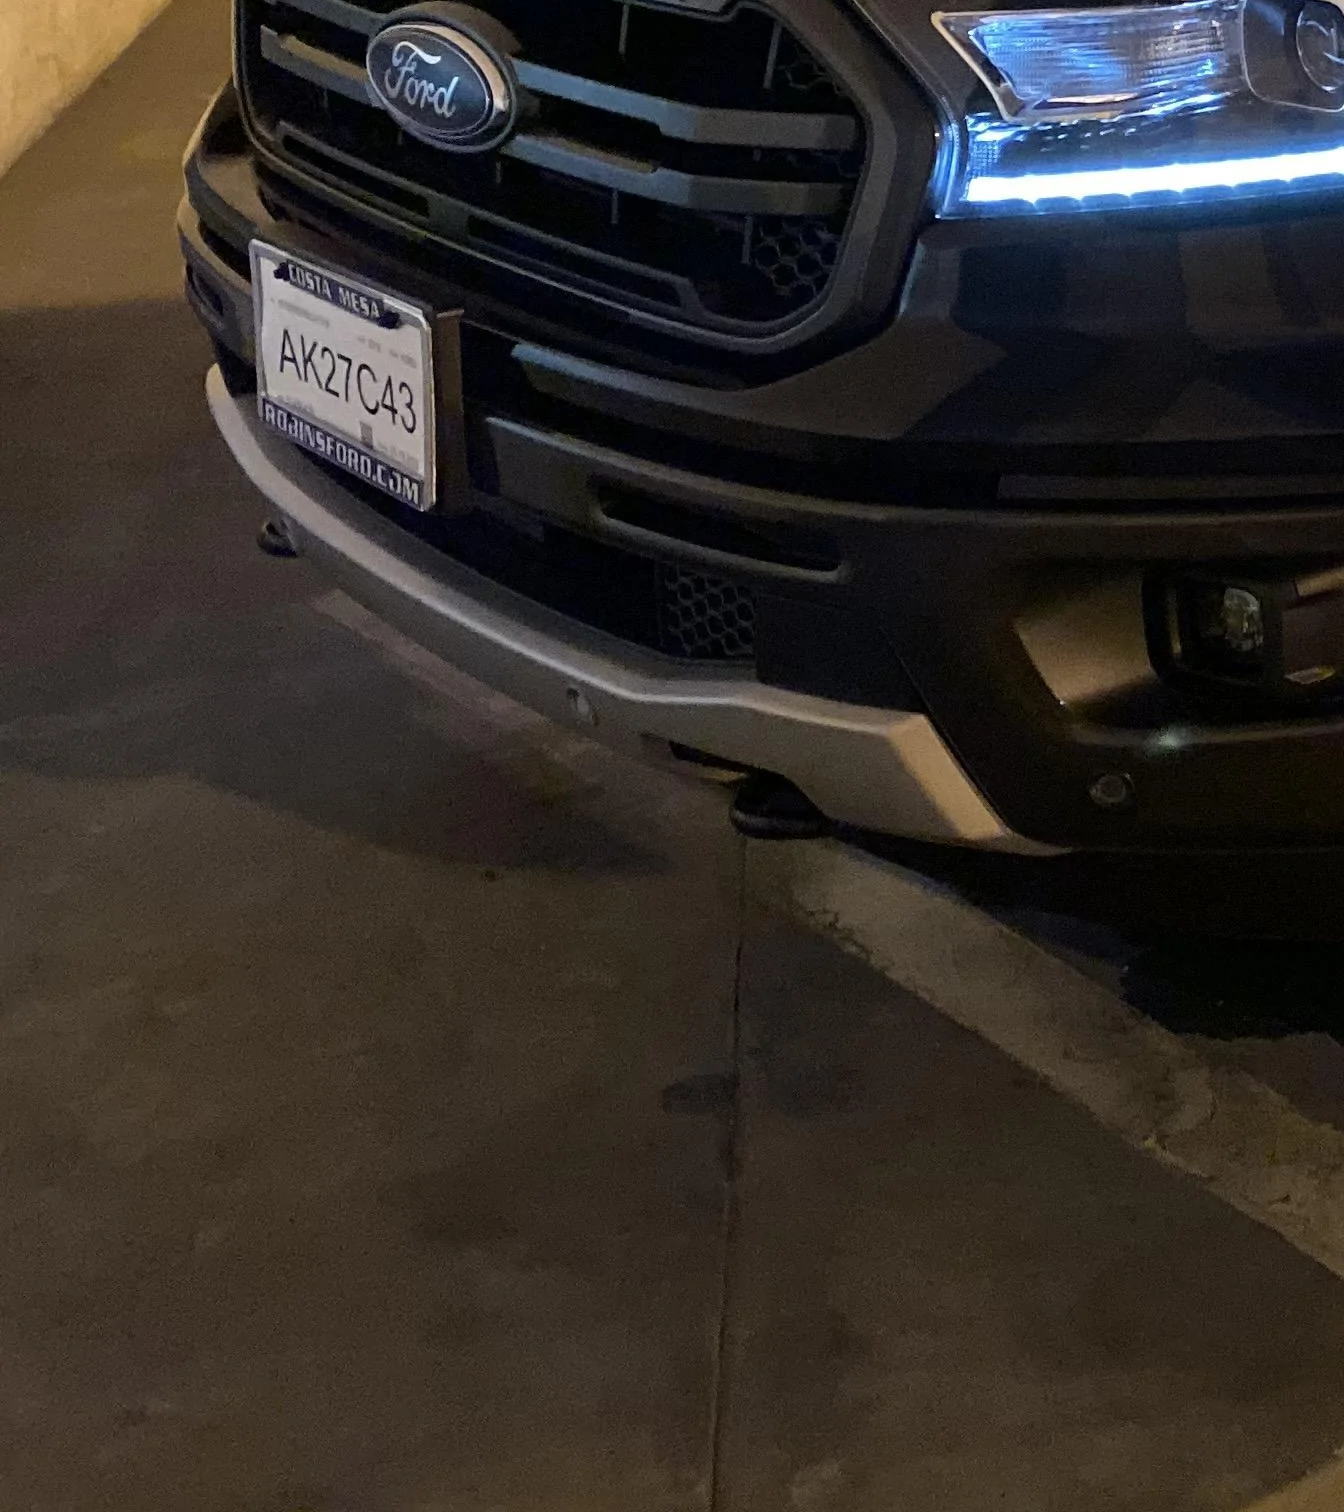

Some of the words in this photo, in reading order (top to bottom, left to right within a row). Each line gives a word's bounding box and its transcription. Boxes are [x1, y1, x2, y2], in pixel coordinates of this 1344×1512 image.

[384, 40, 460, 119] Ford
[289, 265, 332, 297] COSTA
[339, 287, 380, 319] MESA
[279, 328, 417, 434] AK27C43
